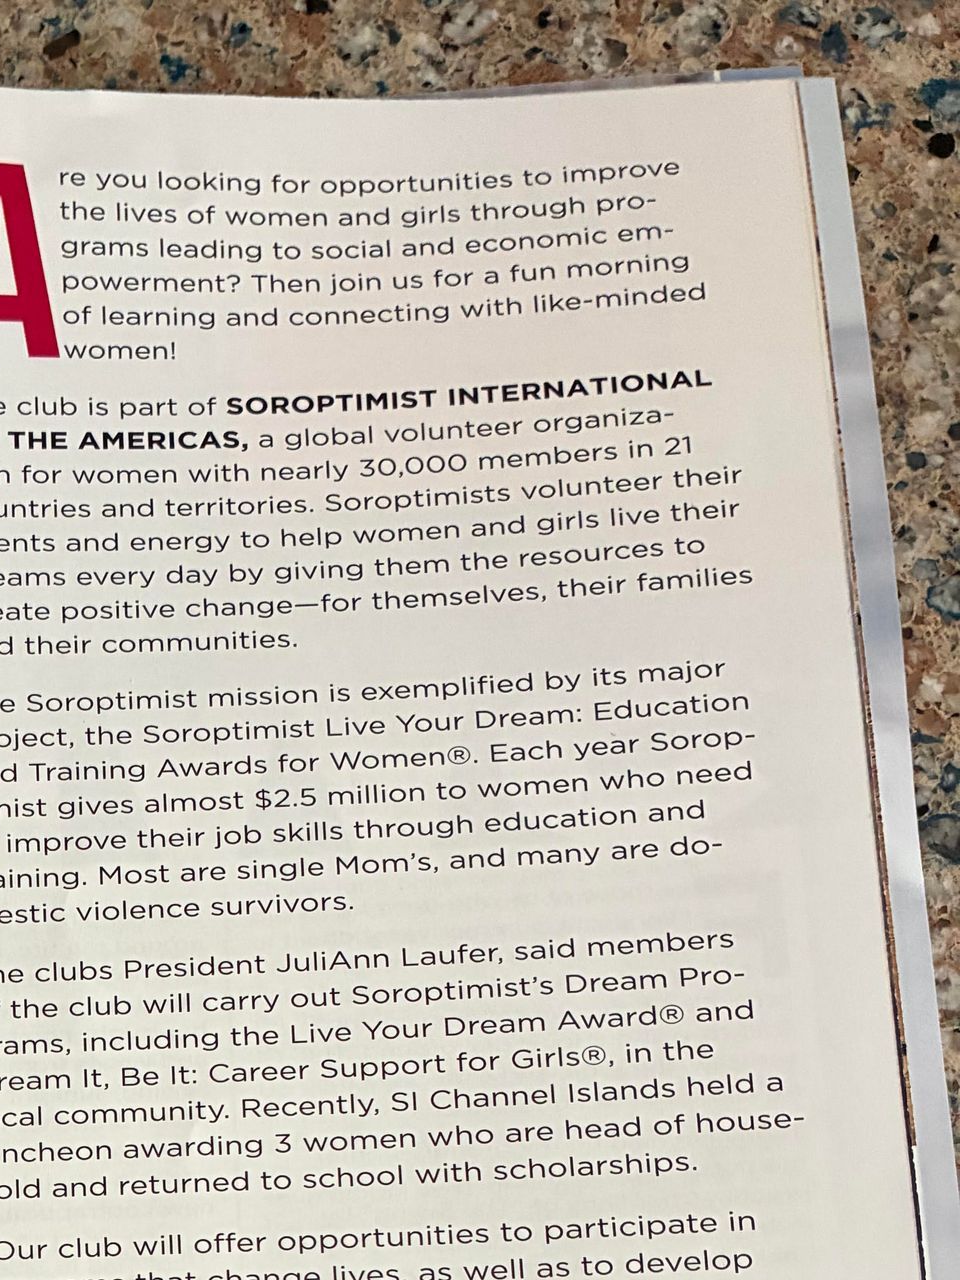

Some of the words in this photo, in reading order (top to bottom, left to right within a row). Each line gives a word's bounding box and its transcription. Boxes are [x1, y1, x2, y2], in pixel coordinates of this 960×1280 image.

[60, 172, 85, 186] re
[96, 173, 146, 191] you
[158, 171, 260, 196] looking
[271, 174, 310, 193] for
[321, 172, 512, 197] opportunities
[523, 170, 552, 186] to
[563, 162, 679, 184] improve
[17, 396, 77, 416] club
[89, 397, 108, 416] is
[120, 399, 177, 420] part
[188, 397, 217, 416] of
[227, 390, 437, 415] SOROPTIMIST
[449, 369, 712, 406] INTERNATIONAL
[8, 431, 68, 450] THE
[78, 431, 248, 452] AMERICAS,
[259, 434, 273, 448] a
[285, 425, 373, 451] global
[384, 420, 523, 443] volunteer
[534, 408, 674, 434] organiza-
[28, 761, 145, 782] Training
[157, 755, 267, 778] Awards
[278, 753, 319, 773] for
[330, 746, 478, 770] Women®.
[490, 740, 562, 762] Each
[573, 733, 639, 761] year
[651, 731, 755, 751] Sorop-
[76, 900, 200, 921] violence
[211, 894, 353, 916] survivors.
[35, 961, 112, 982] clubs
[125, 955, 265, 979] President
[276, 951, 389, 972] JuliAnn
[402, 944, 503, 967] Laufer,
[515, 938, 575, 960] said
[588, 932, 734, 956] members
